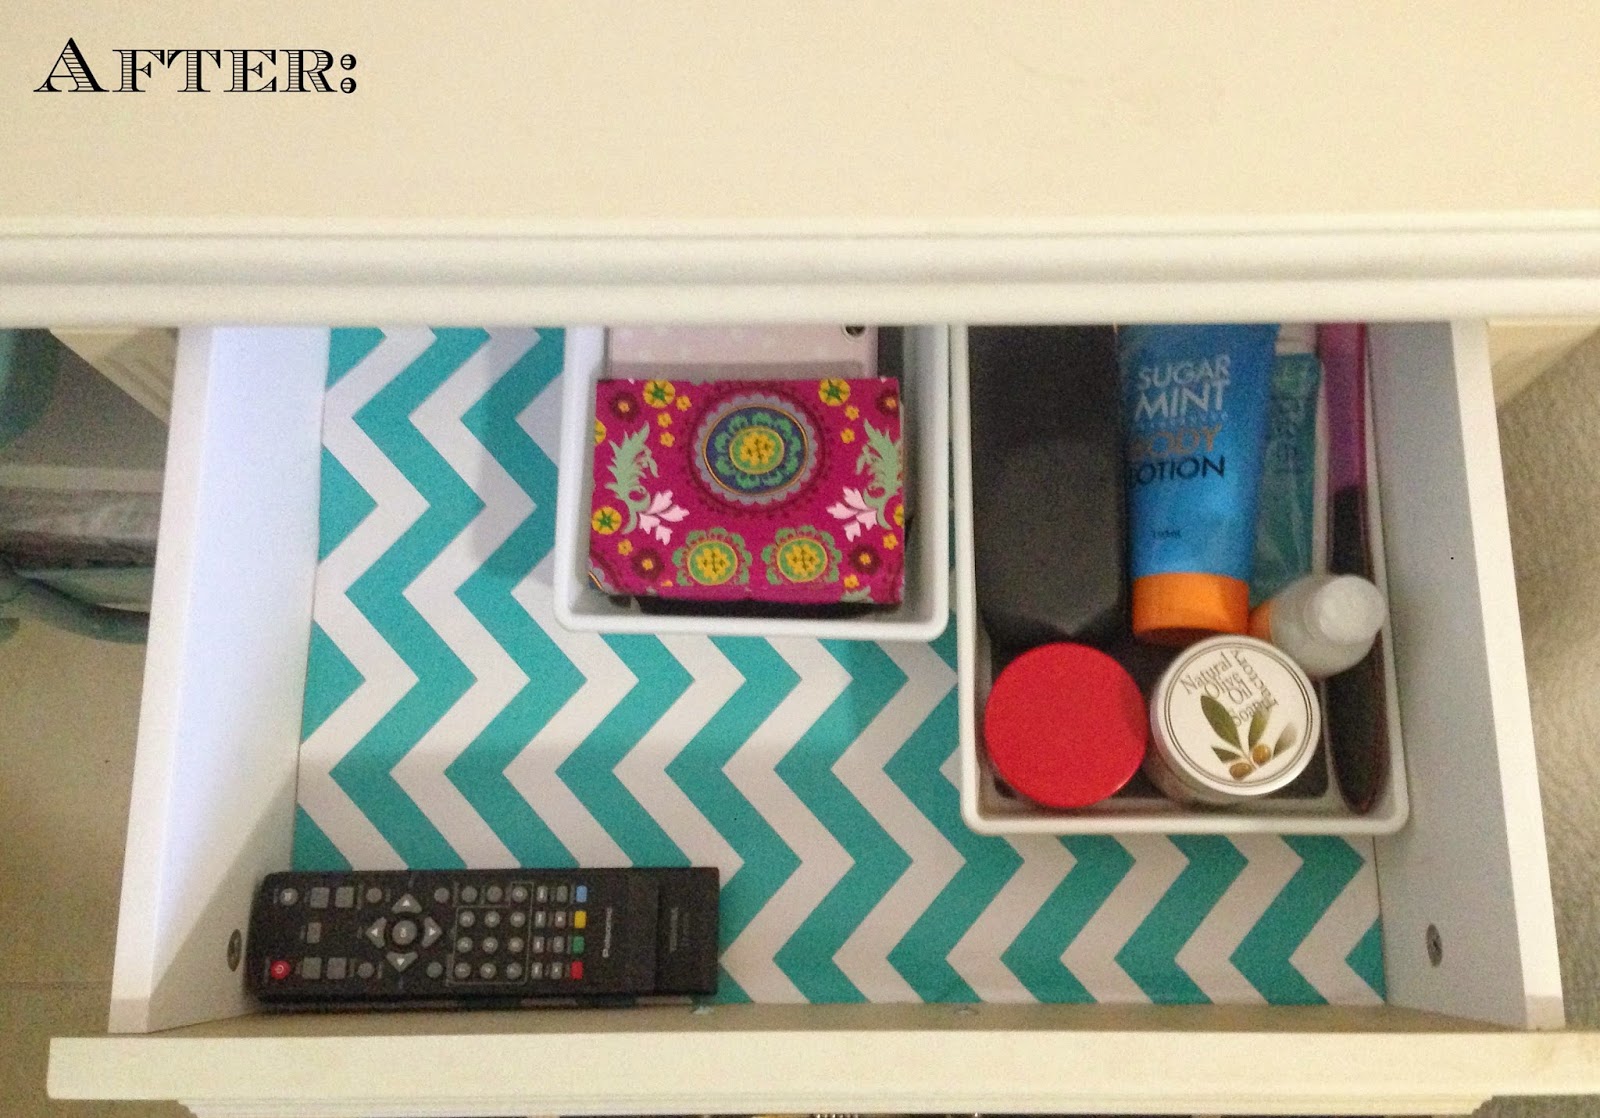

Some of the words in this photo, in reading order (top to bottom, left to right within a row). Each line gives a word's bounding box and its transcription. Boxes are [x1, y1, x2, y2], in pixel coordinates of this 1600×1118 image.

[1138, 353, 1231, 390] SUGAR
[1133, 378, 1231, 420] MINT
[1180, 651, 1233, 695] Natural
[1204, 673, 1241, 700] Olive
[1228, 678, 1253, 705] Oil
